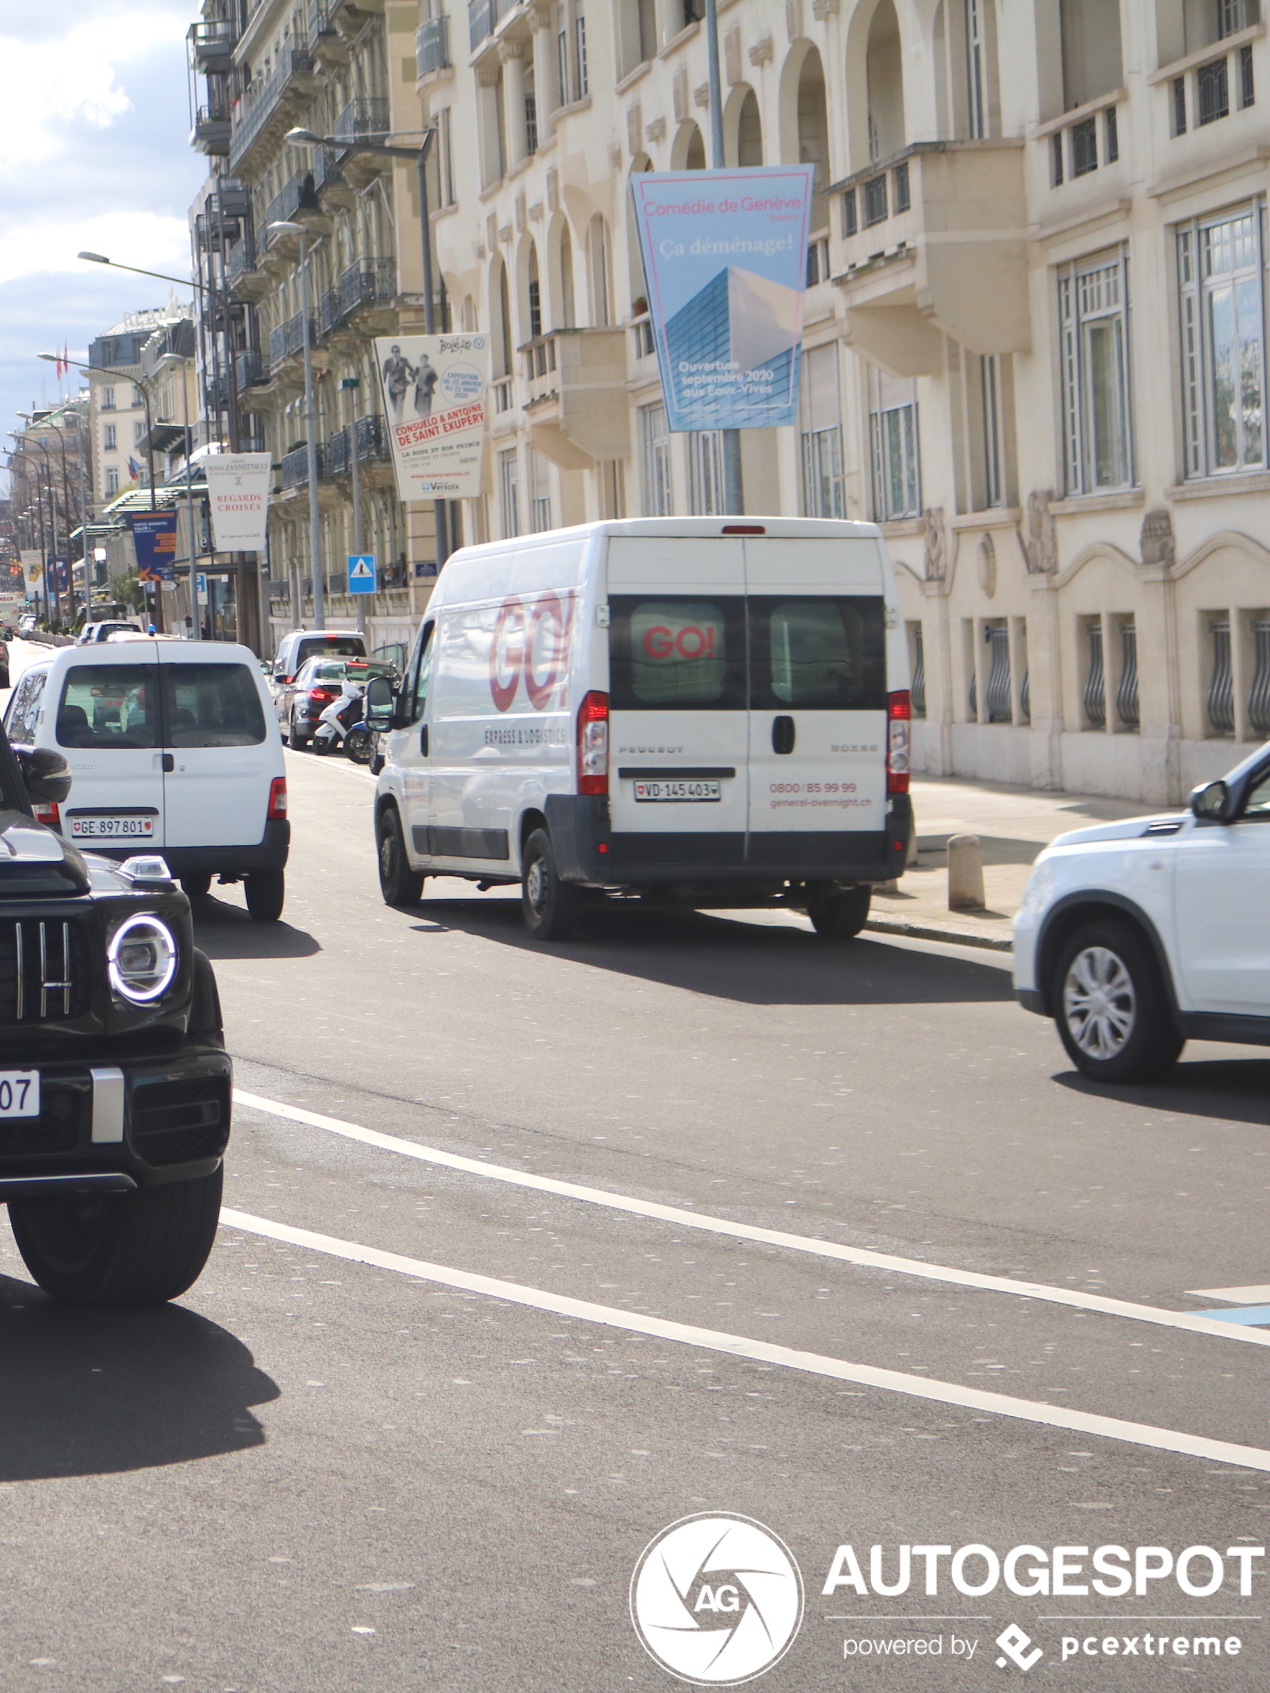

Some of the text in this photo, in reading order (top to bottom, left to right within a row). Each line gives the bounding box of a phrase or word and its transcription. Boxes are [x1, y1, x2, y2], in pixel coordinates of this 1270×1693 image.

[643, 196, 801, 216] Comédie de Genève
[659, 239, 686, 261] Ça
[679, 361, 740, 372] Ouverture
[682, 370, 774, 386] septembre 2020
[683, 384, 772, 397] aux Eaux-Vives
[395, 403, 483, 436] CONSUELO & ANTOINE
[398, 412, 484, 446] DE SAINT EXUPERY
[456, 441, 480, 450] PRINCE
[430, 482, 460, 491] Versoix
[218, 502, 261, 512] CROISÉS
[643, 626, 715, 658] GO!
[489, 588, 575, 712] GO!
[485, 729, 566, 744] EXPRESS & LOGISTICS
[770, 798, 872, 809] general-overnight.ch
